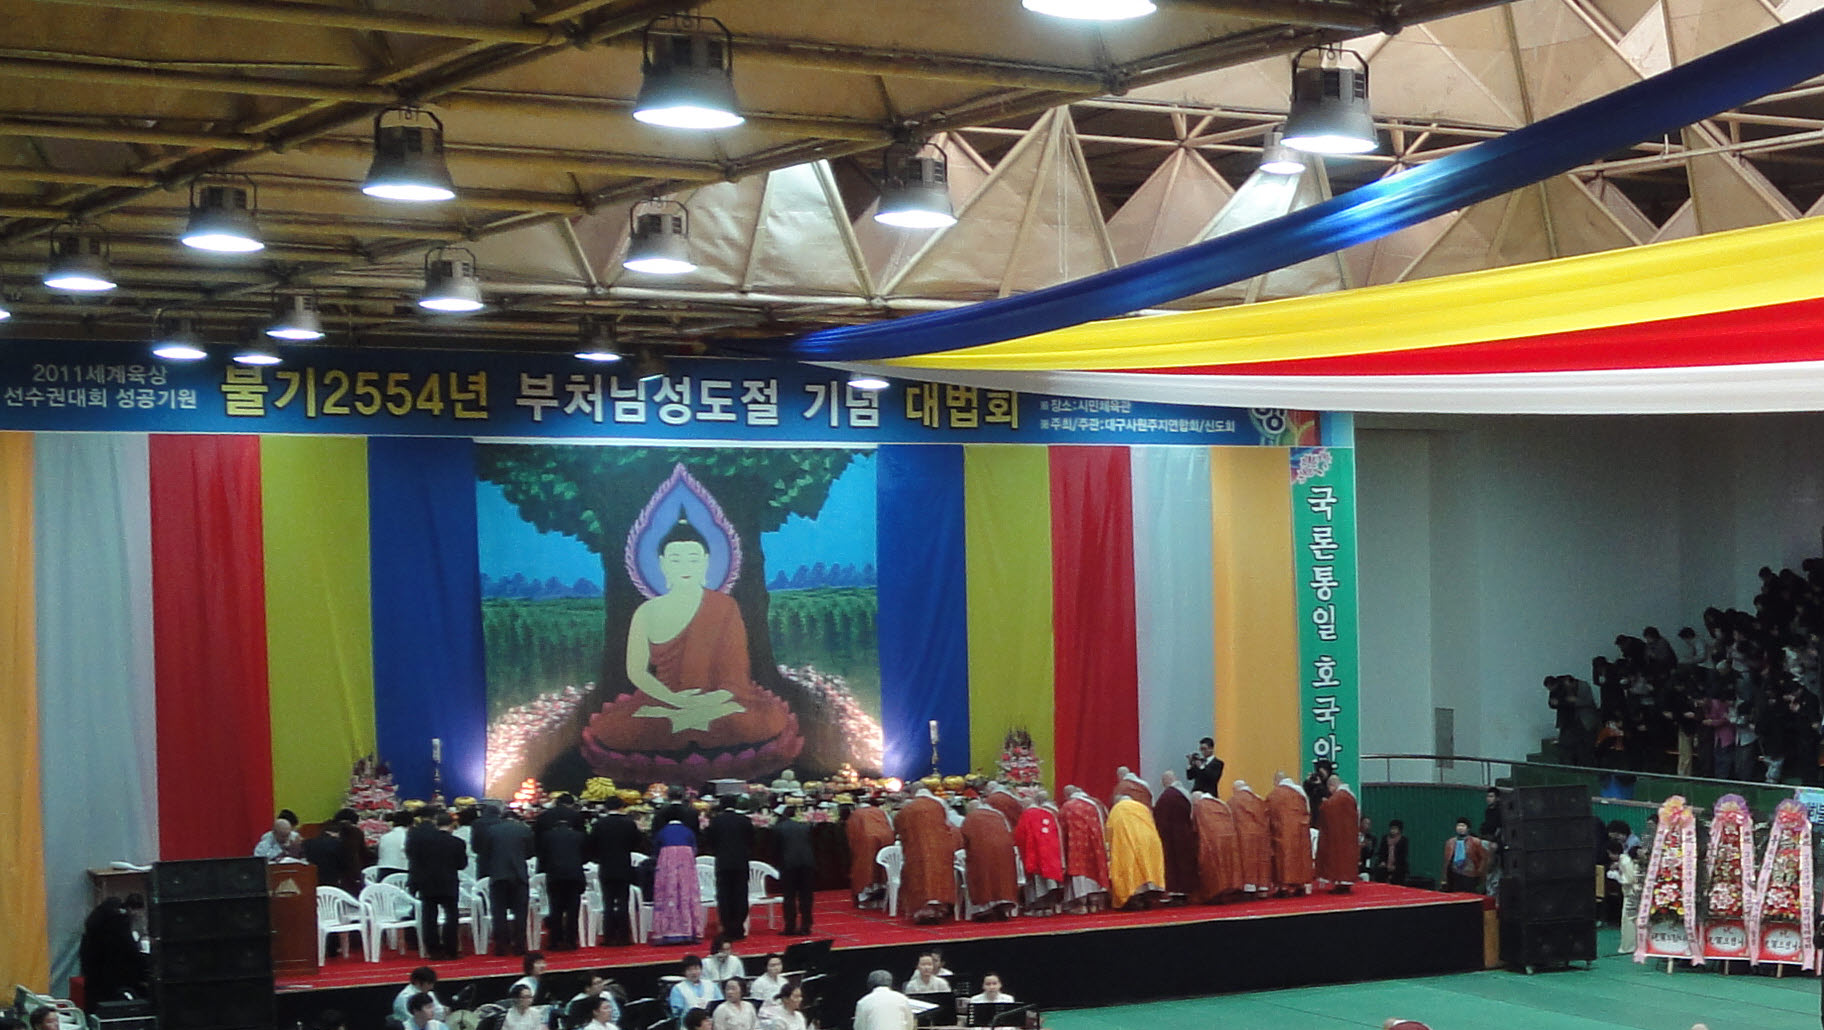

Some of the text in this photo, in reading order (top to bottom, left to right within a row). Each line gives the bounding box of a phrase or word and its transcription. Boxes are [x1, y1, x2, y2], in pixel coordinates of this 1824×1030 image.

[32, 363, 168, 386] 2011세계육상
[4, 387, 197, 409] 선수권대회 성공기원
[220, 364, 1019, 430] 불기2554년 부처님성도절 기념 대법회
